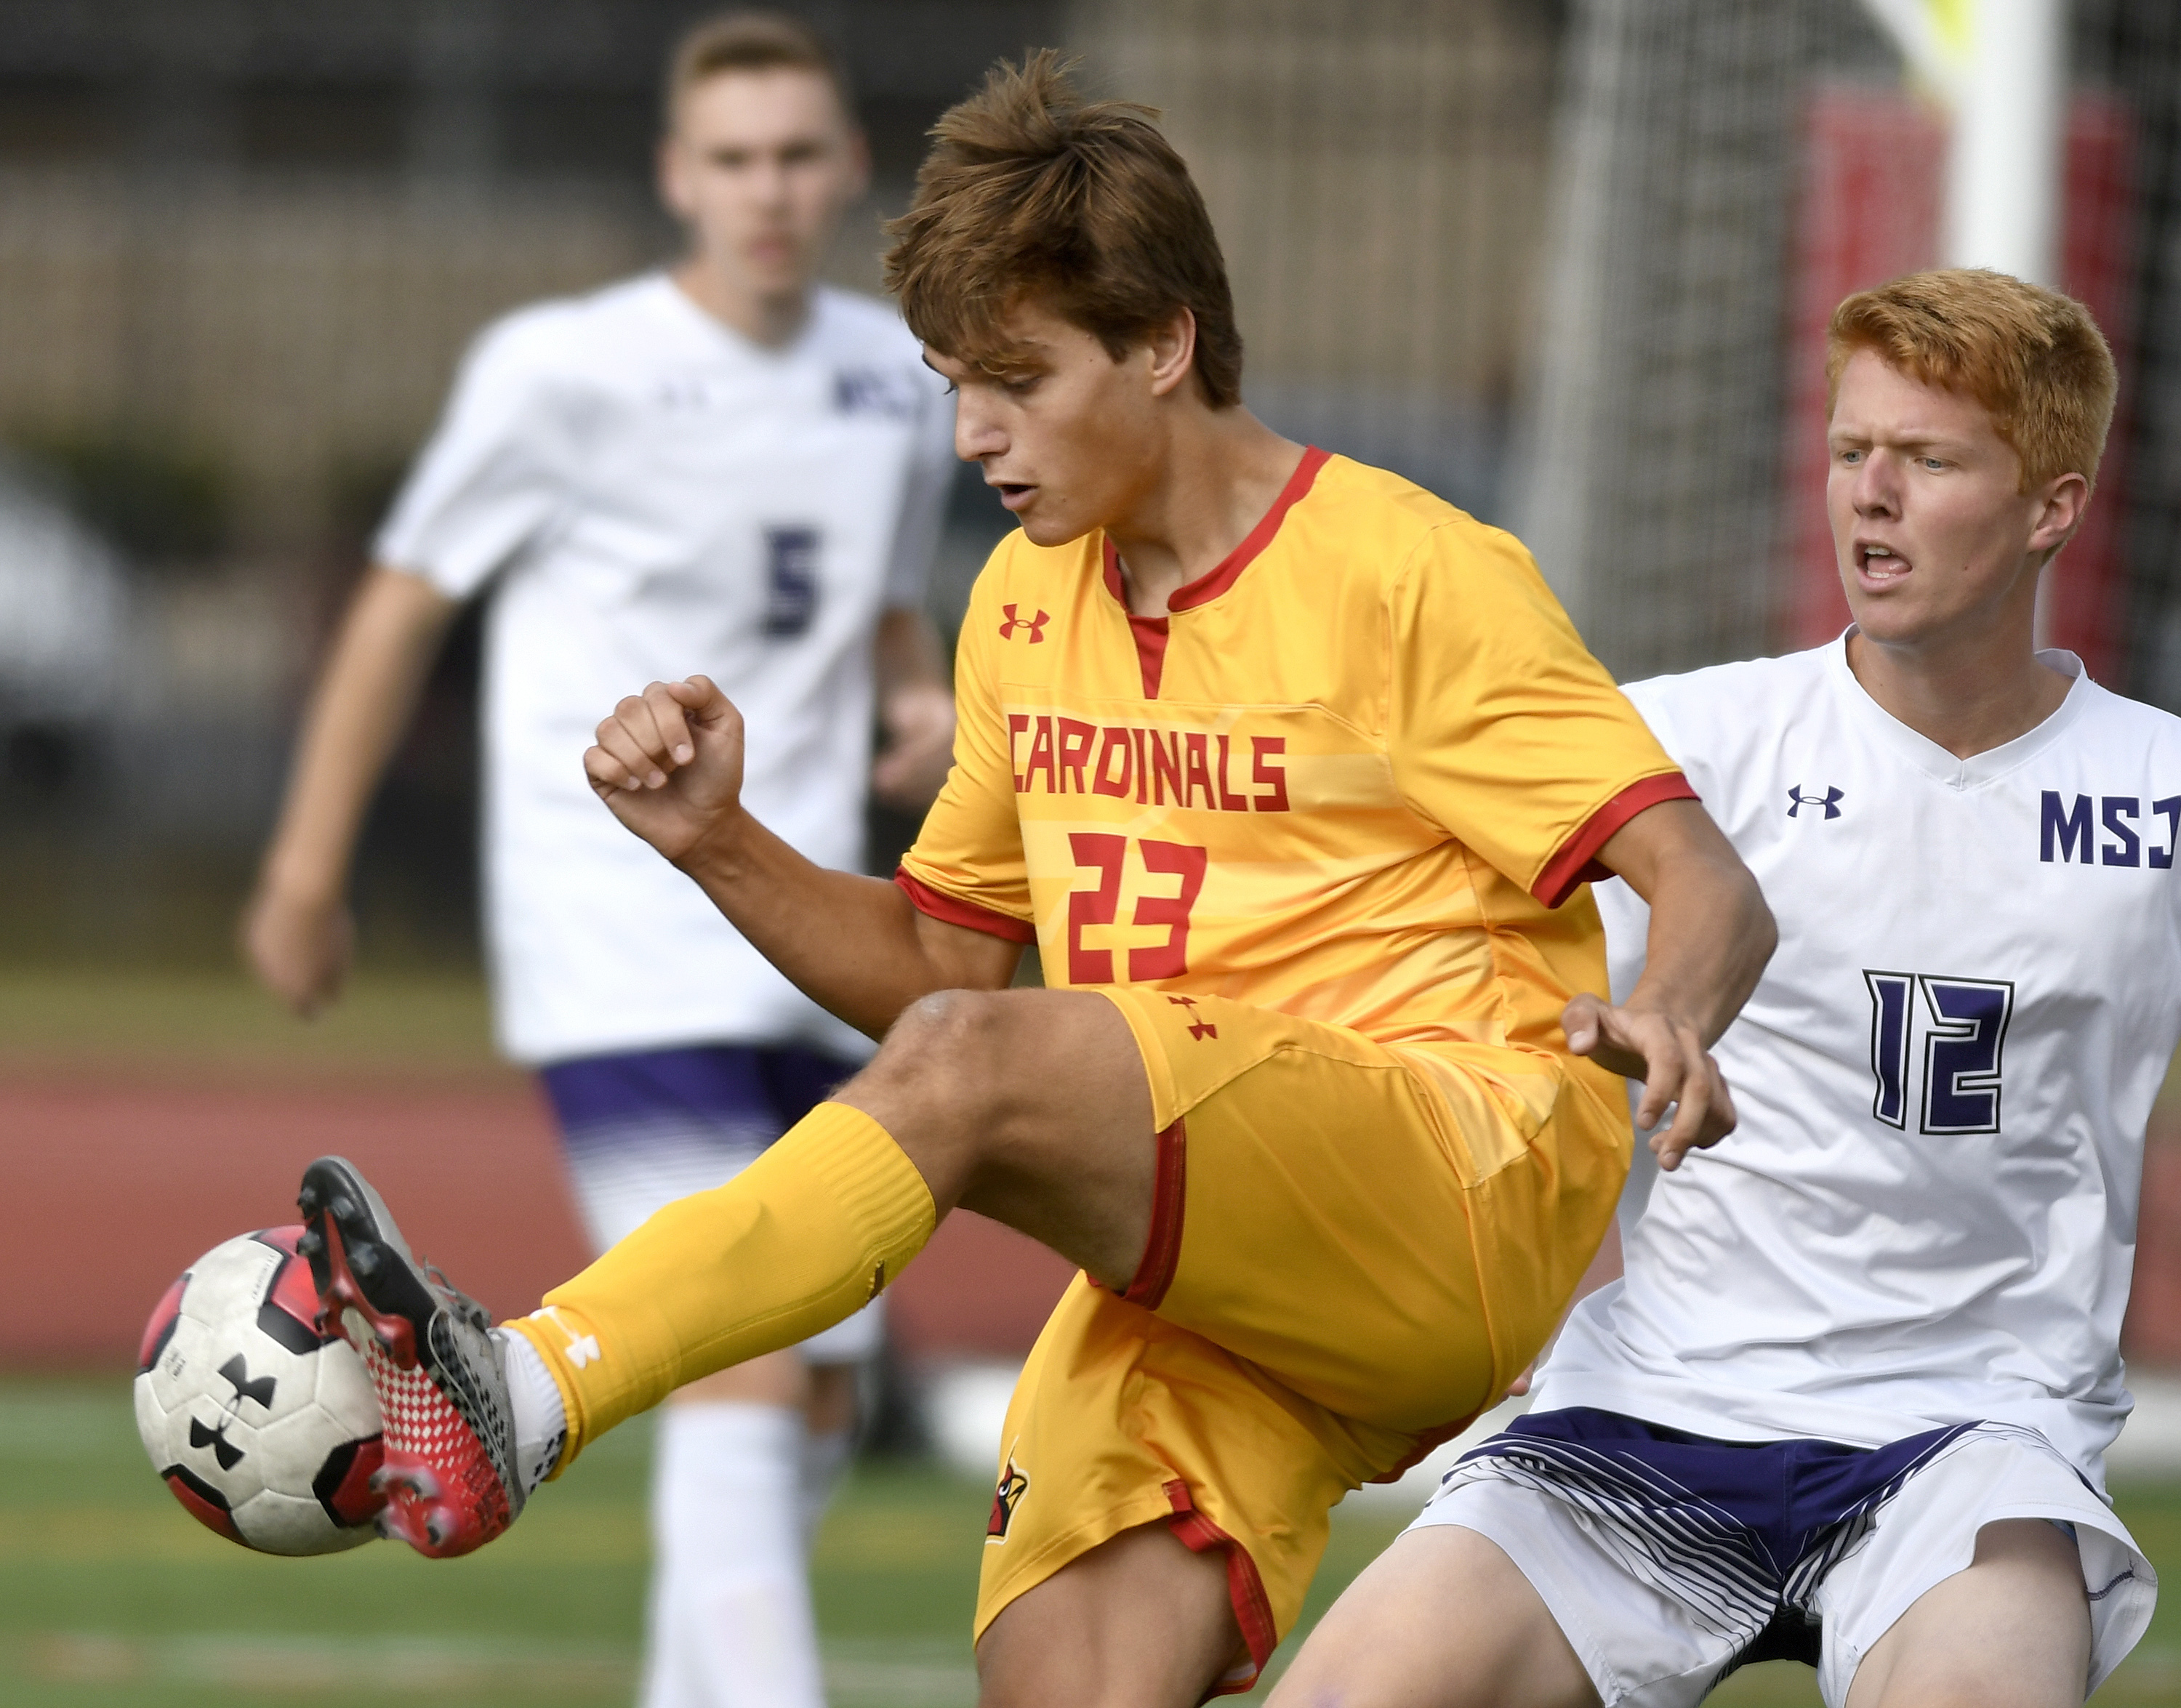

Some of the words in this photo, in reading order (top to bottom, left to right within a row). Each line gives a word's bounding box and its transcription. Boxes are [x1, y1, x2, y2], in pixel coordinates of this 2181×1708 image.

[762, 524, 822, 640] 5
[1008, 714, 1290, 812] CARDINALS
[2040, 789, 2181, 869] MSJ
[1068, 832, 1208, 985] 23
[1862, 968, 2016, 1135] 12
